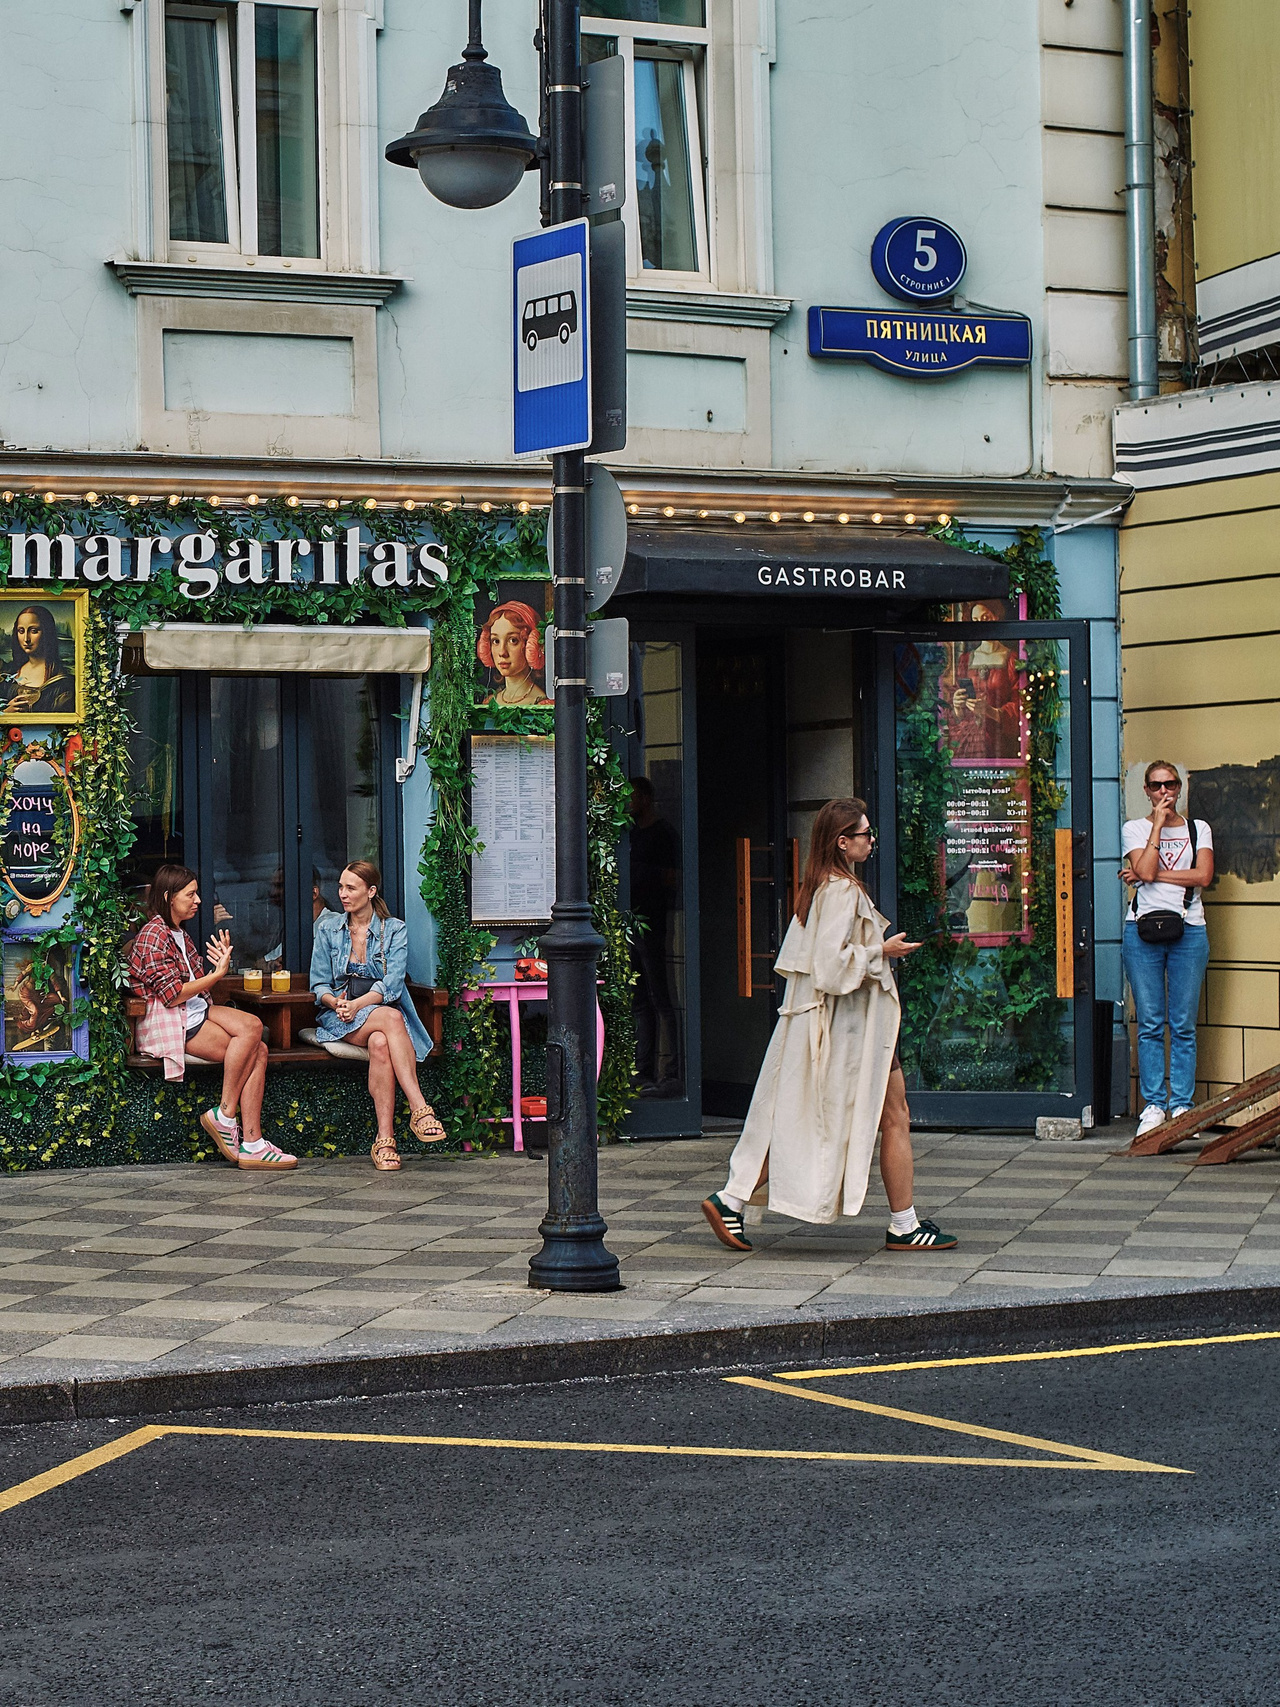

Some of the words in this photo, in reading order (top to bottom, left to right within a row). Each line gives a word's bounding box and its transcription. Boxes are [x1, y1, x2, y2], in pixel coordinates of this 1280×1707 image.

[914, 229, 937, 272] 5
[900, 274, 946, 291] СТРОЕНИЕ
[866, 319, 987, 345] ПЯТНИЦКАЯ
[905, 350, 948, 364] УЛИЦА
[7, 526, 450, 600] margaritas
[757, 566, 907, 589] GASTROBAR
